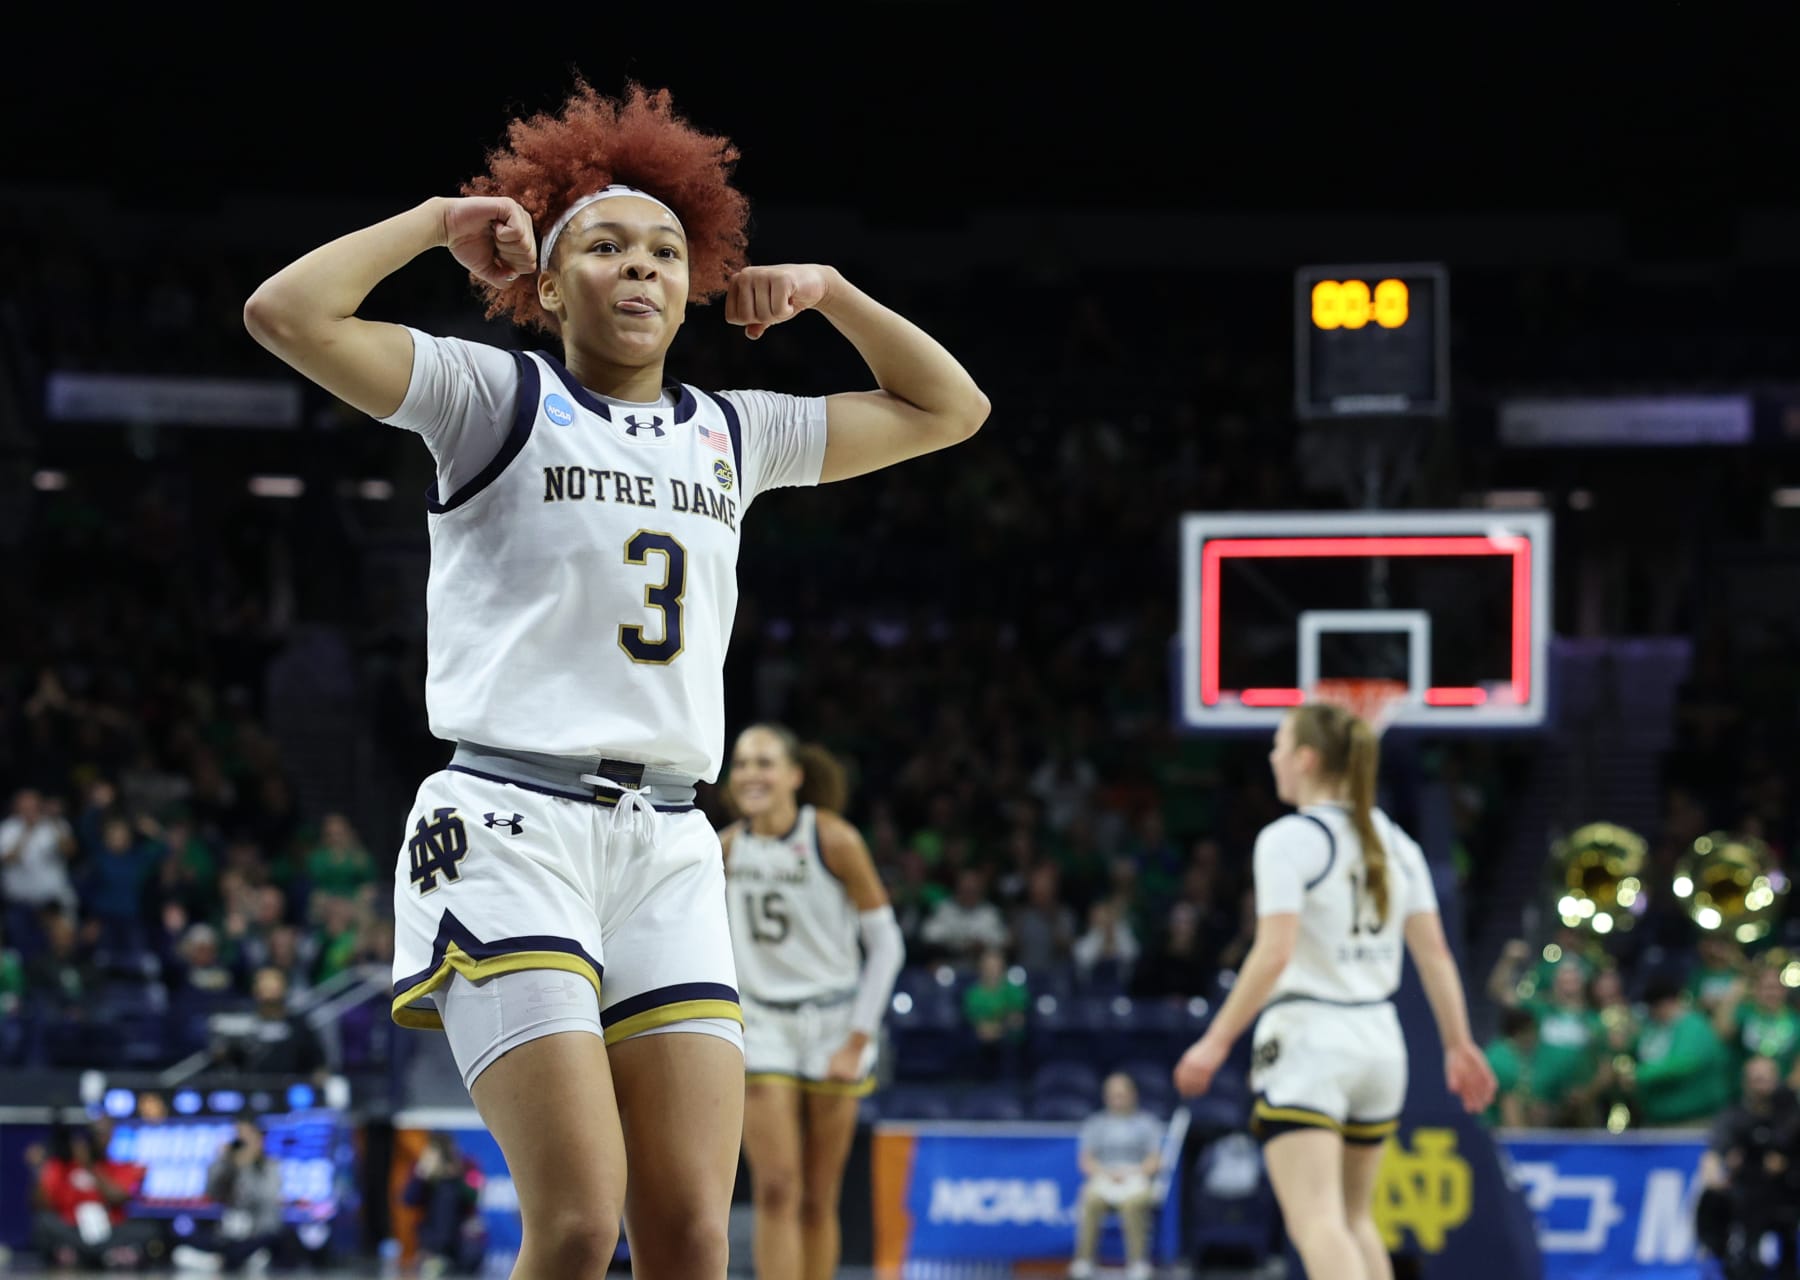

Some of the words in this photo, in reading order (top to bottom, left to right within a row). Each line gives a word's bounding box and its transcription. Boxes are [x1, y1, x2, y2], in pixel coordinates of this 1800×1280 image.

[543, 466, 656, 508] NOTRE
[669, 478, 736, 534] DAME
[617, 528, 687, 665] 3
[744, 891, 790, 945] 15
